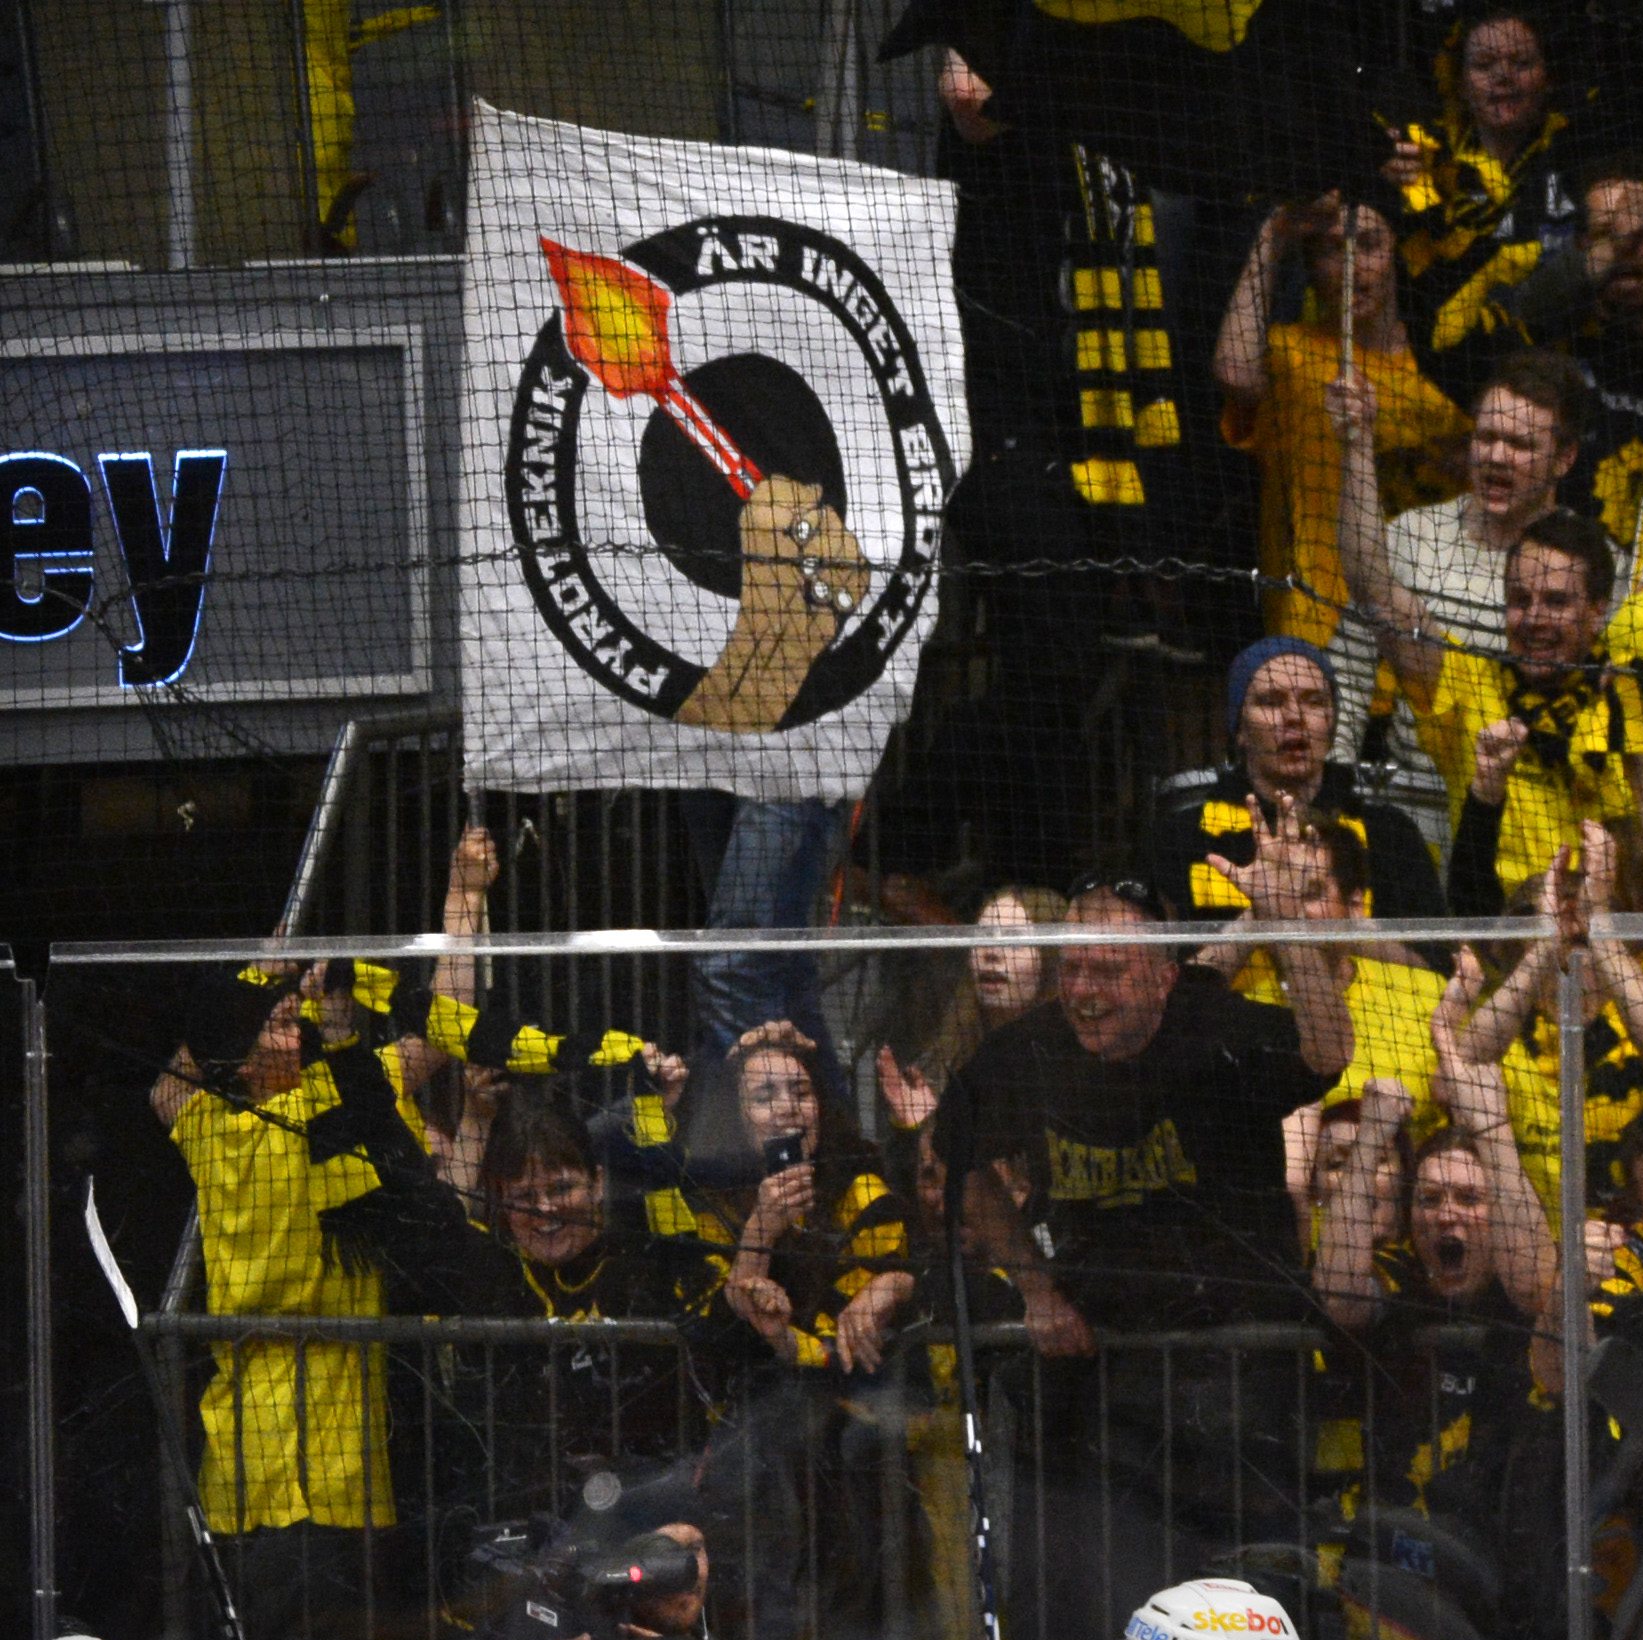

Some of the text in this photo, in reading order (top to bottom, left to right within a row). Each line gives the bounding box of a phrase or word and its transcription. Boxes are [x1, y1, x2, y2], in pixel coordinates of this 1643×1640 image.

[697, 226, 780, 275] ÄR
[802, 245, 917, 400] INGET
[0, 449, 228, 688] ey
[1193, 1607, 1285, 1636] skebo
